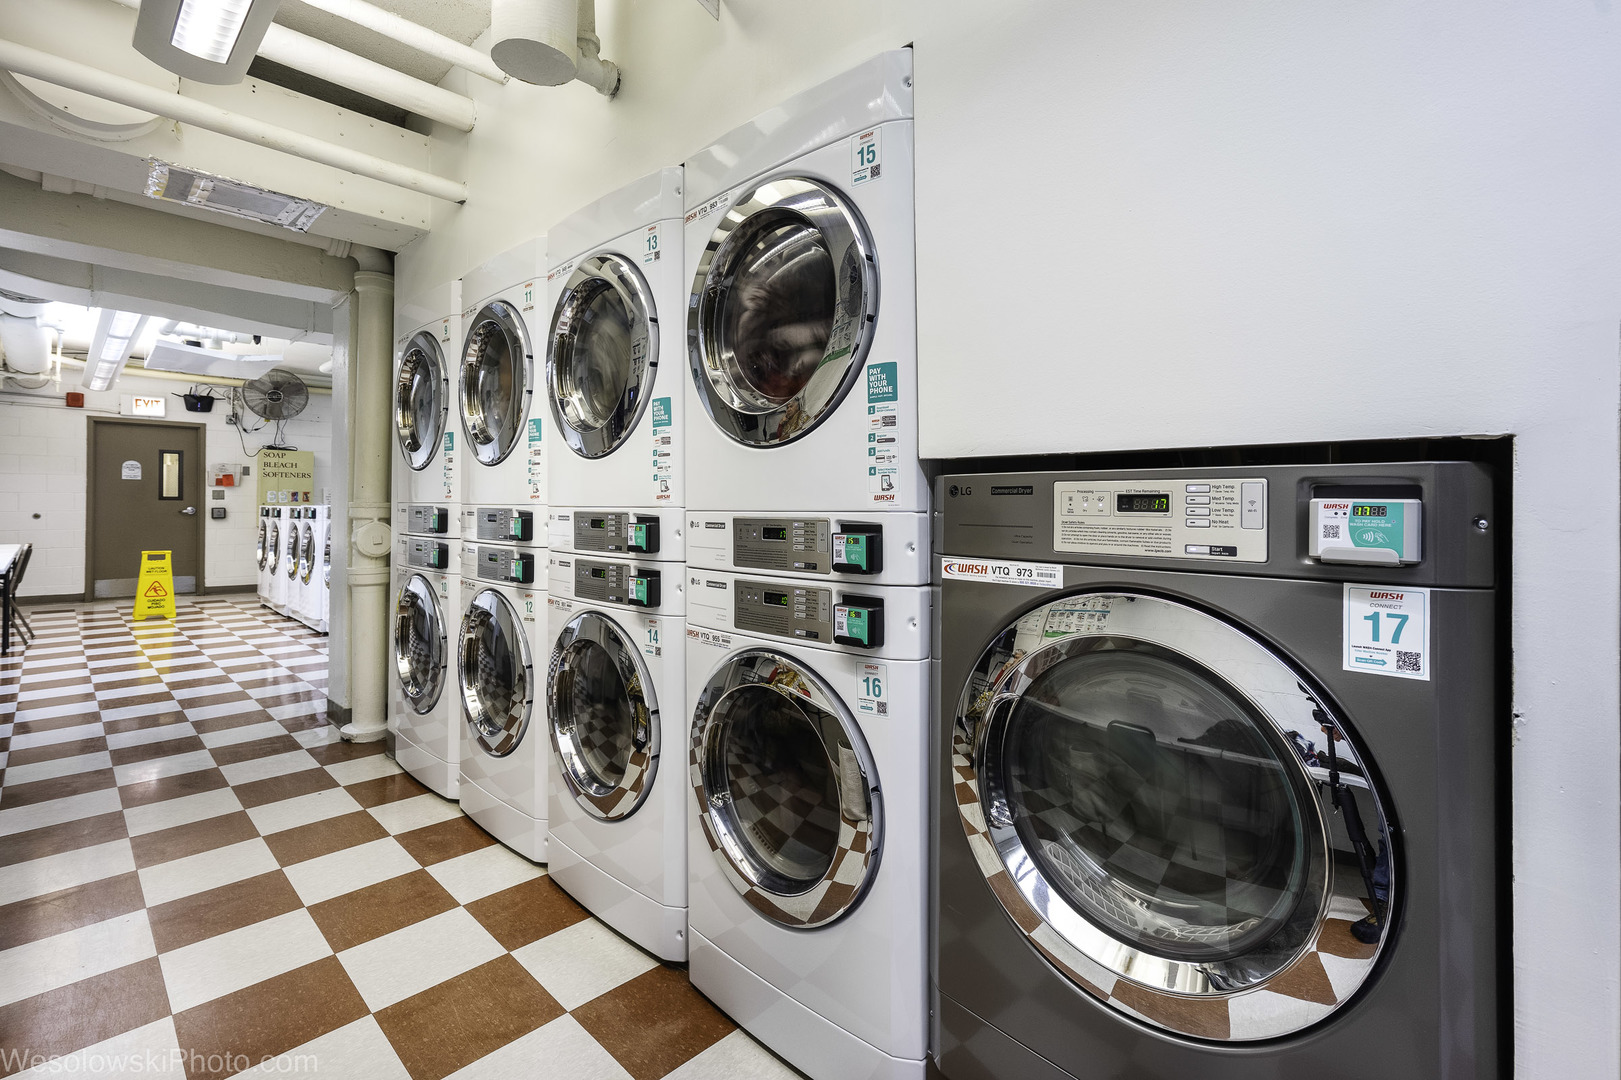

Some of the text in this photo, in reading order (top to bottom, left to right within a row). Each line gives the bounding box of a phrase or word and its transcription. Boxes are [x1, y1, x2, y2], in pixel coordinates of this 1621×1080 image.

[858, 143, 876, 166] 15
[647, 235, 657, 251] 13
[525, 290, 531, 302] 11
[870, 386, 893, 394] PHONE
[960, 487, 971, 495] LG
[1155, 499, 1166, 509] 17
[958, 564, 988, 574] WASH
[991, 566, 1010, 576] VTQ
[1017, 568, 1033, 577] 973
[1370, 592, 1404, 600] WASH
[525, 601, 532, 613] 12
[1364, 611, 1409, 644] 17
[648, 629, 658, 644] 14
[863, 677, 881, 697] 16
